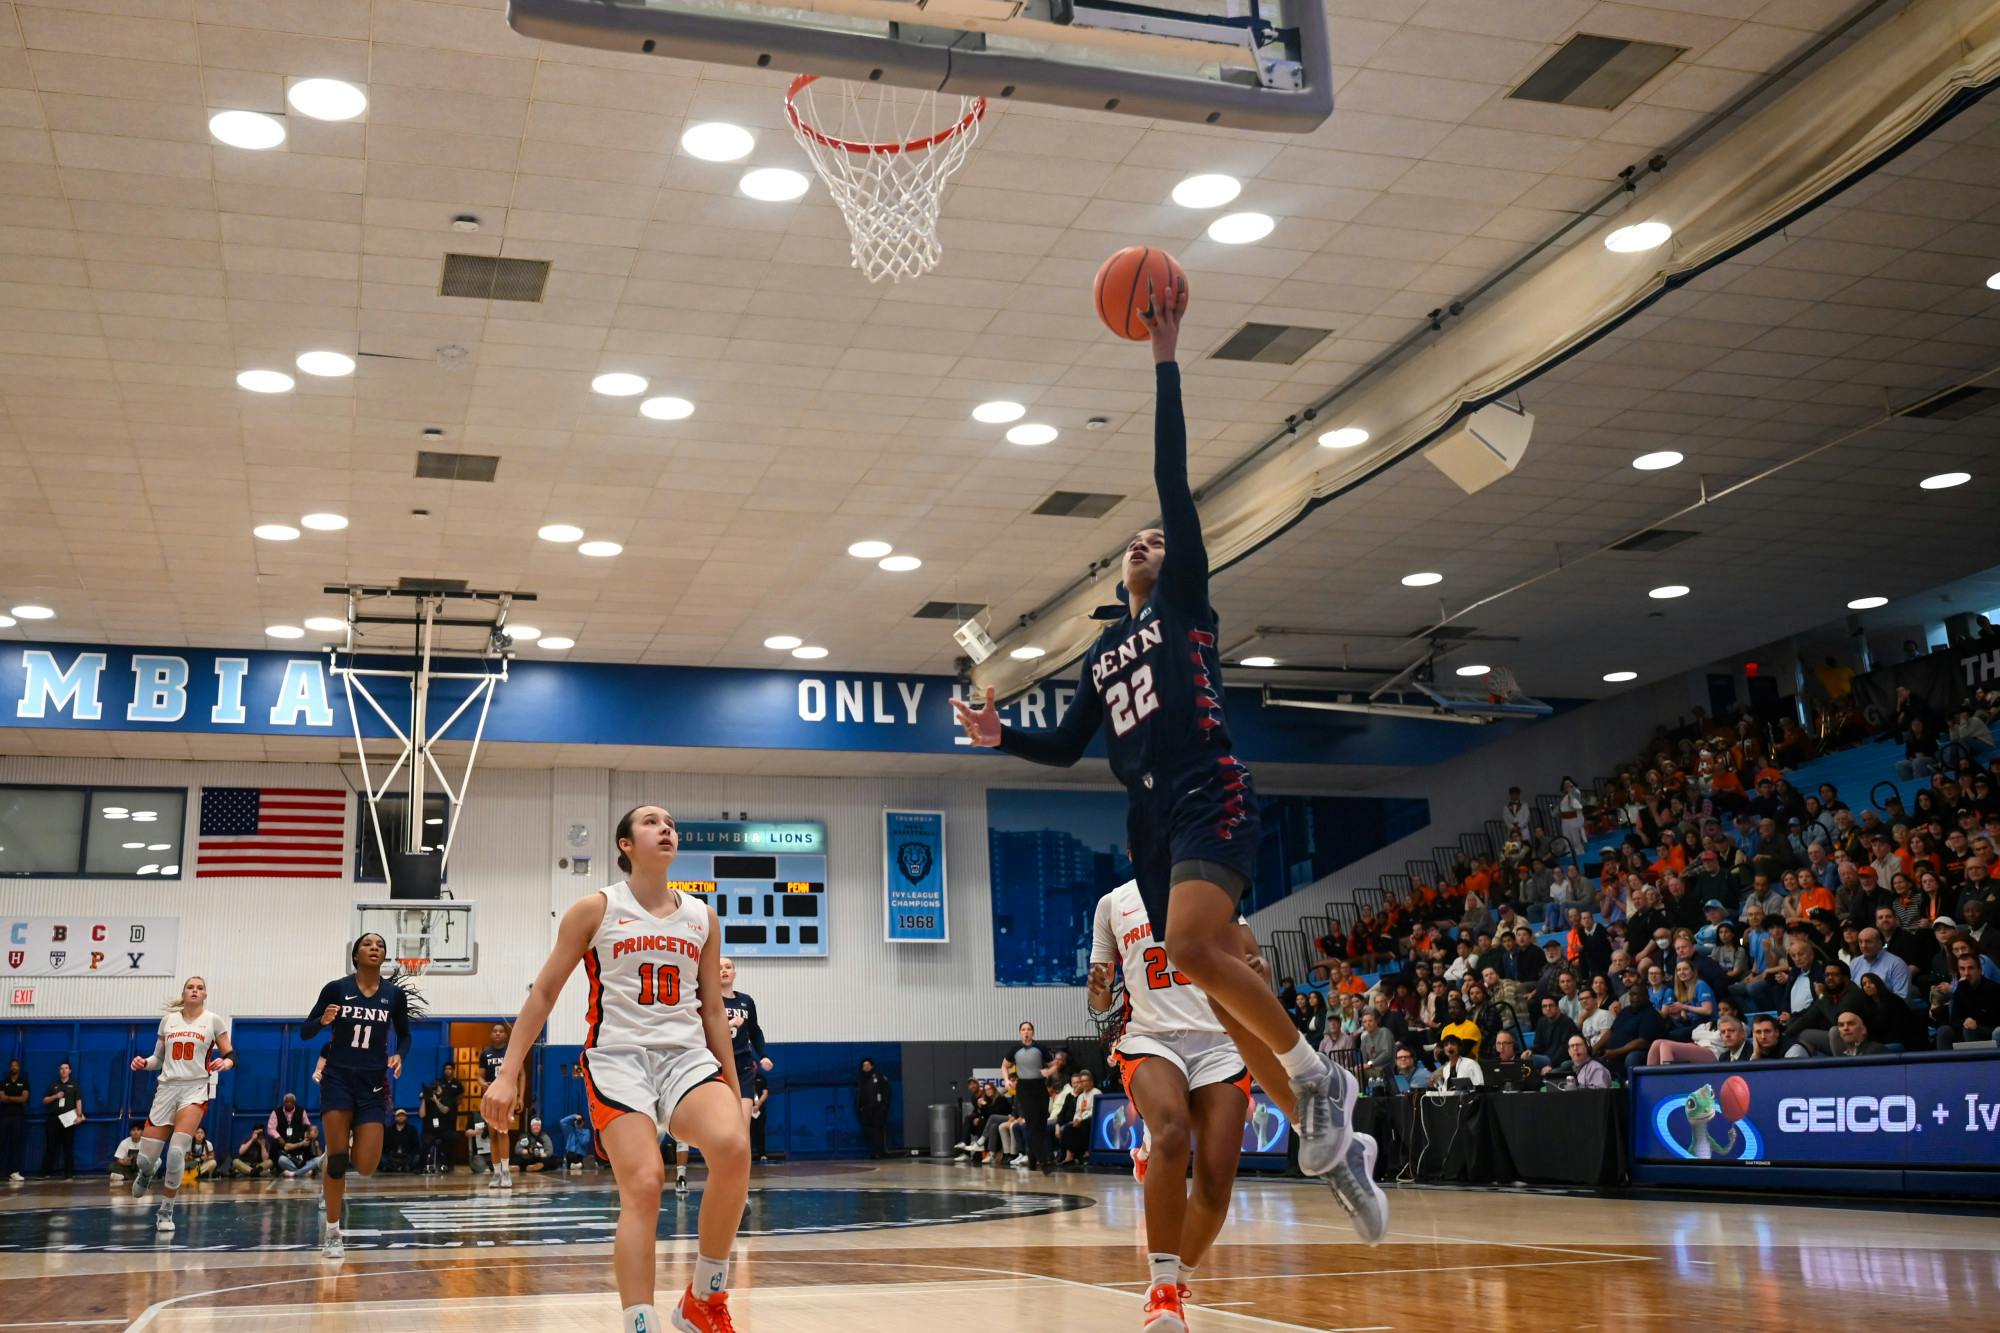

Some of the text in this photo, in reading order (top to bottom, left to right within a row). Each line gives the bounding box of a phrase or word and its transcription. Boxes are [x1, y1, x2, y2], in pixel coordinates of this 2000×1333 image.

[1092, 619, 1163, 692] PENN
[17, 650, 333, 727] MBIA
[798, 679, 925, 725] ONLY
[1105, 664, 1160, 737] 22
[770, 833, 813, 843] LIONS
[667, 881, 715, 893] PRINCETON
[787, 882, 810, 893] PENN
[892, 891, 939, 899] IVY LEAGUE
[900, 915, 934, 929] 1968
[11, 923, 28, 944] C
[52, 925, 67, 942] B
[92, 925, 106, 942] C
[130, 925, 145, 943] D
[613, 935, 700, 962] PRINCETON
[90, 952, 104, 970] P
[128, 953, 144, 969] Y
[638, 963, 680, 1006] 10
[14, 989, 34, 1003] EXIT
[341, 1005, 390, 1022] PENN
[726, 1007, 748, 1020] ENN
[166, 1031, 206, 1042] PRINCETON
[350, 1024, 372, 1049] 11
[172, 1041, 195, 1061] 00
[487, 1057, 504, 1066] PEN
[1778, 1095, 1916, 1133] GEICO
